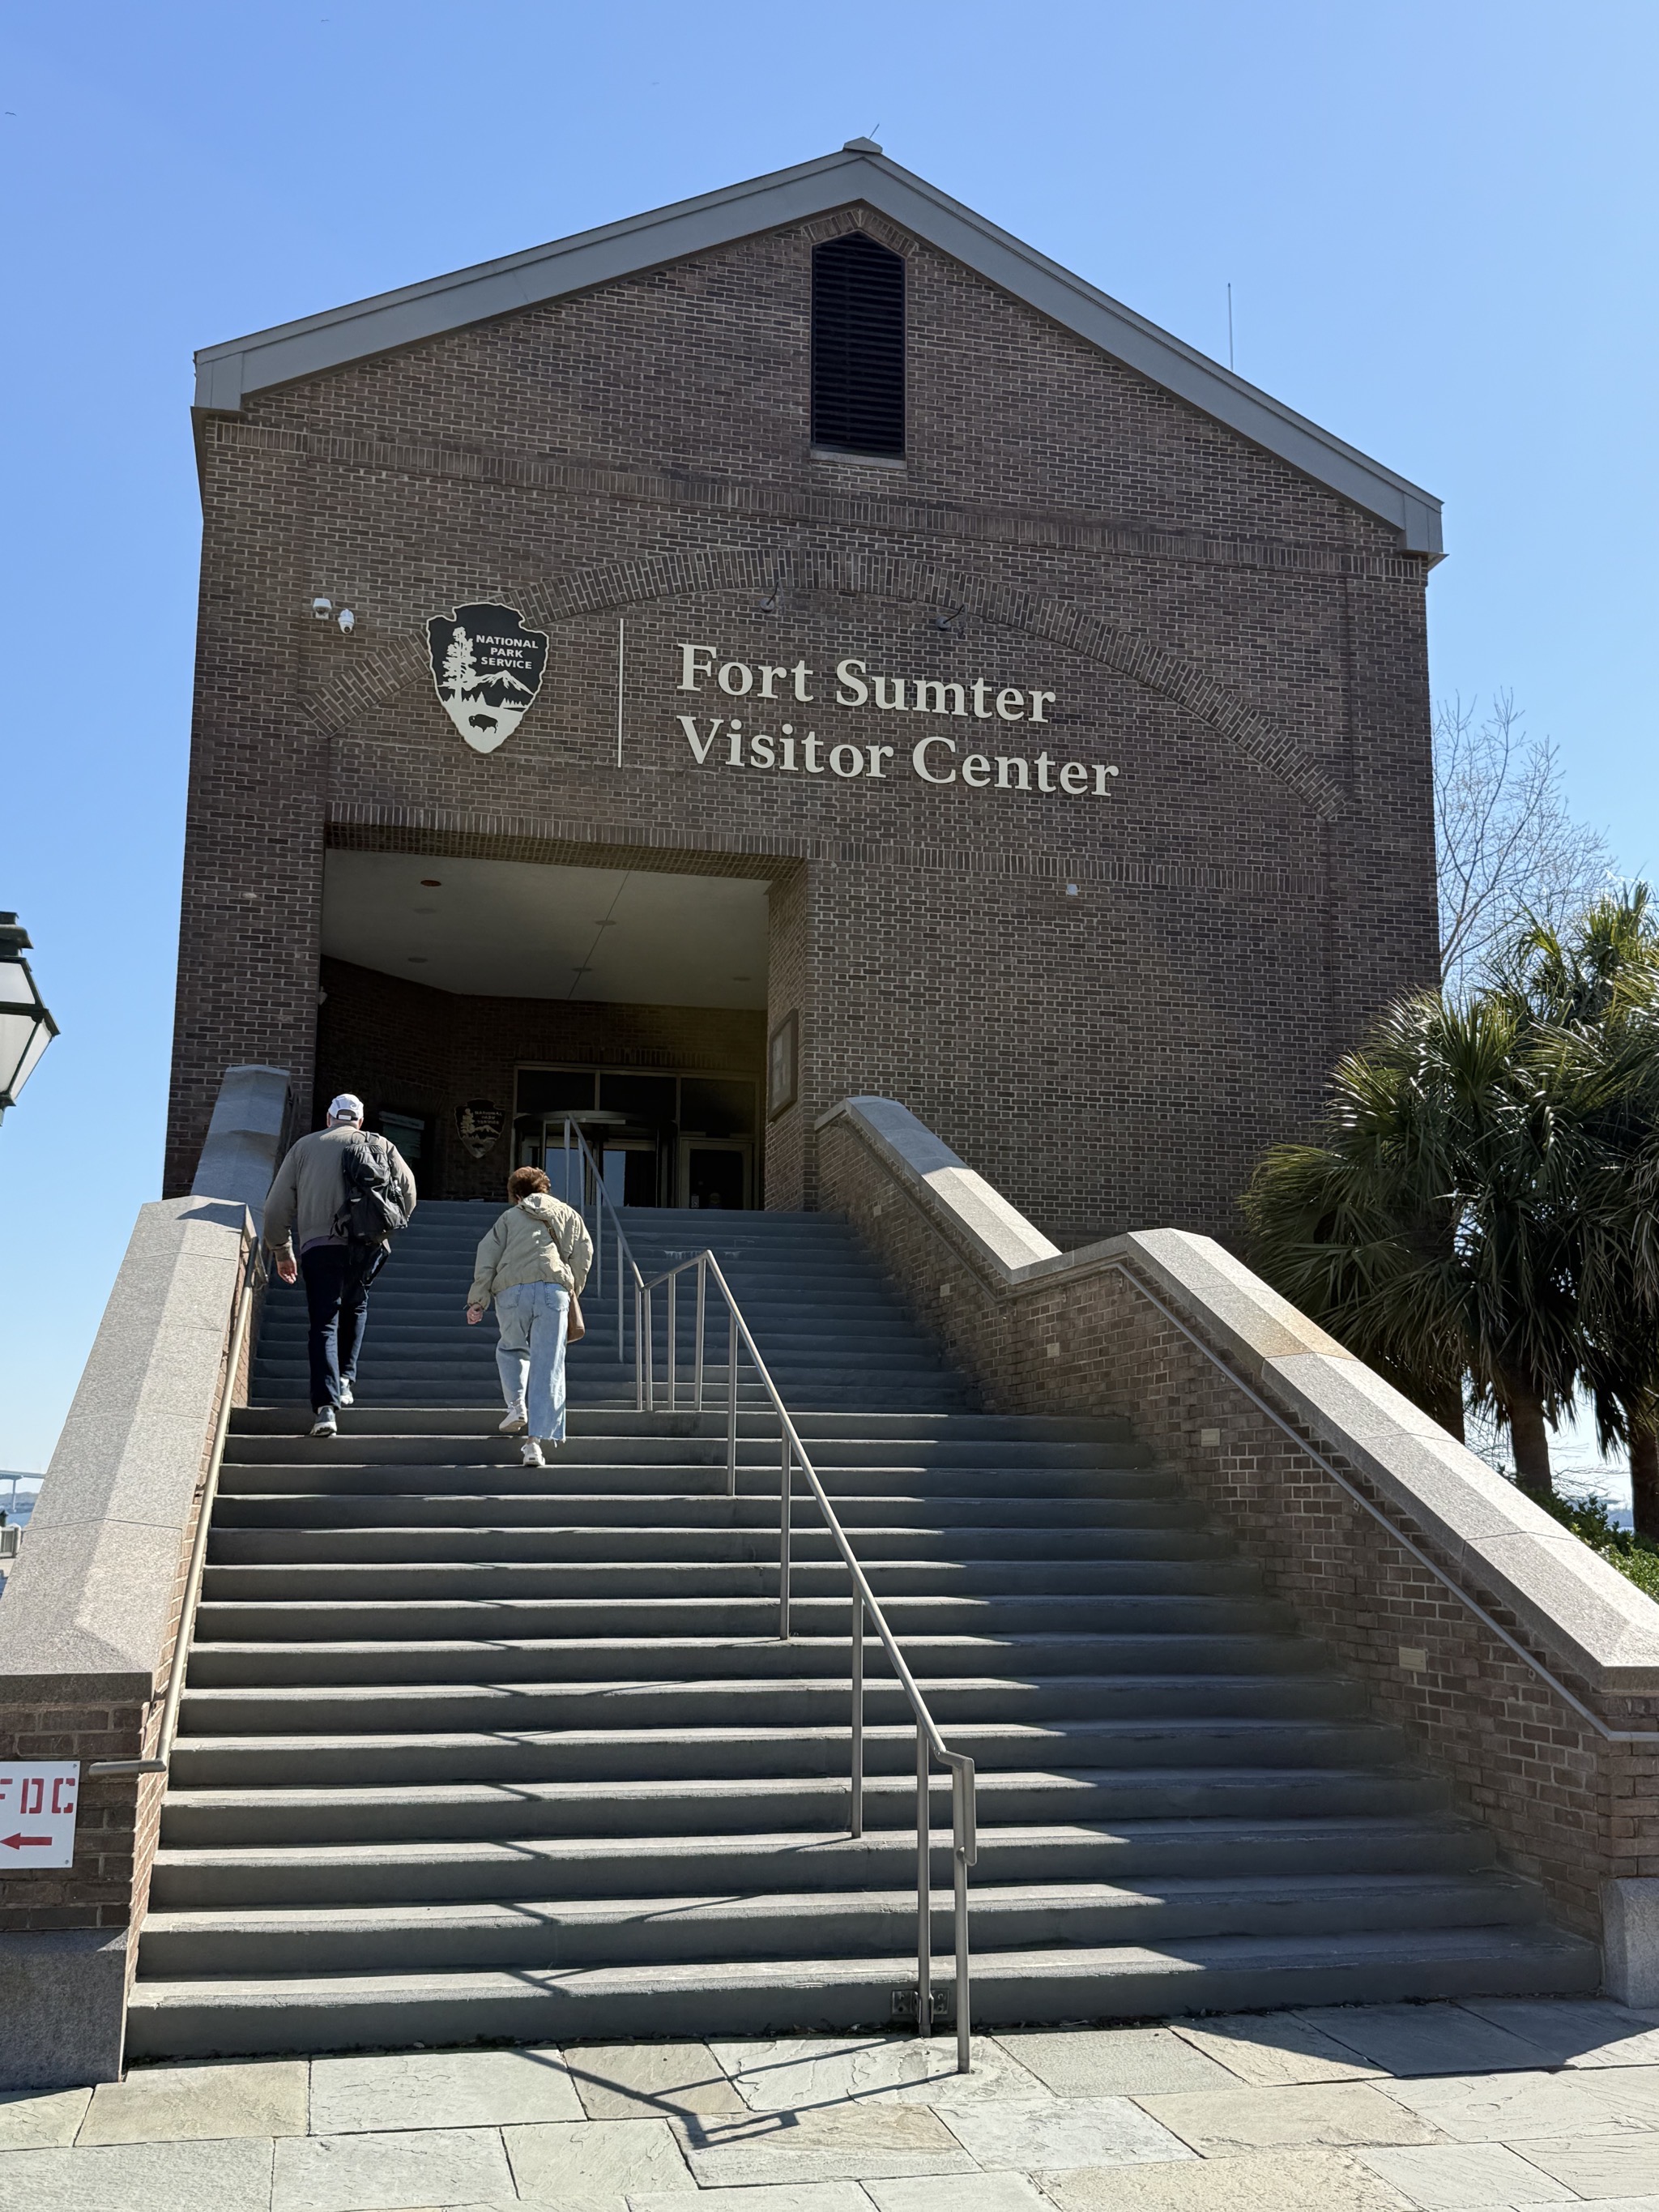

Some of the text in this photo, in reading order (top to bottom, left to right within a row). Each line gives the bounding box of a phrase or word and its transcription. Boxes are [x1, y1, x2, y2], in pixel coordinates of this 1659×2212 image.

[476, 634, 539, 649] NATIONAL
[490, 647, 523, 659] PARK
[480, 656, 532, 670] SERVICE
[677, 643, 1056, 724] Fort Sumter
[676, 715, 1120, 798] Visitor Center
